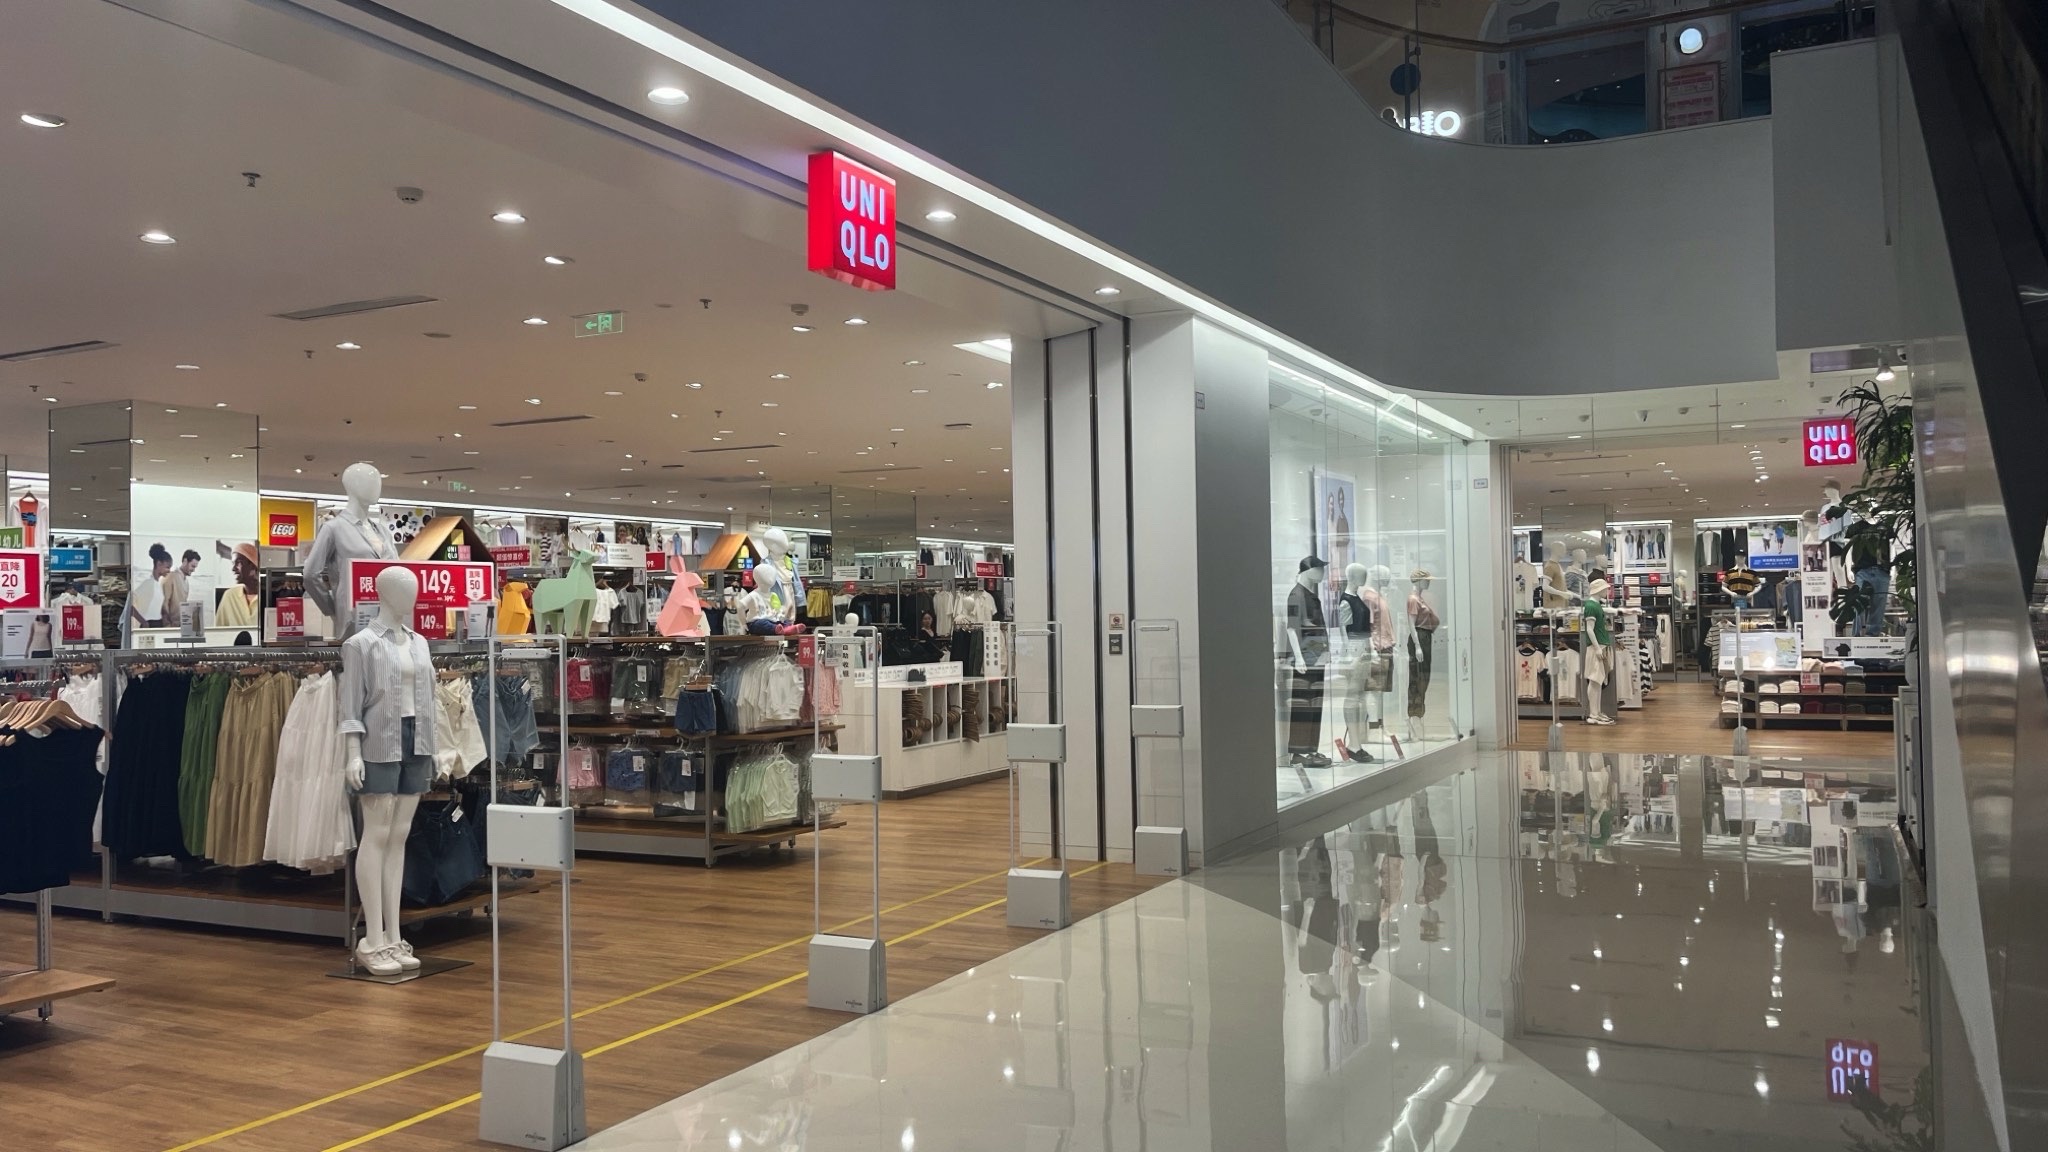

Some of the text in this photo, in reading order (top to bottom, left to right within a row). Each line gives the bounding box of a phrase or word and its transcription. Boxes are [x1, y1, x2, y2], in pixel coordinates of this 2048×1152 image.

[840, 170, 887, 225] UNI
[840, 220, 890, 271] QLO
[1808, 424, 1847, 442] UNI
[1809, 443, 1851, 463] QLO
[270, 523, 296, 537] LEGO
[0, 562, 20, 572] 直降
[2, 574, 18, 588] 20
[470, 580, 480, 590] 50
[6, 589, 15, 599] 元
